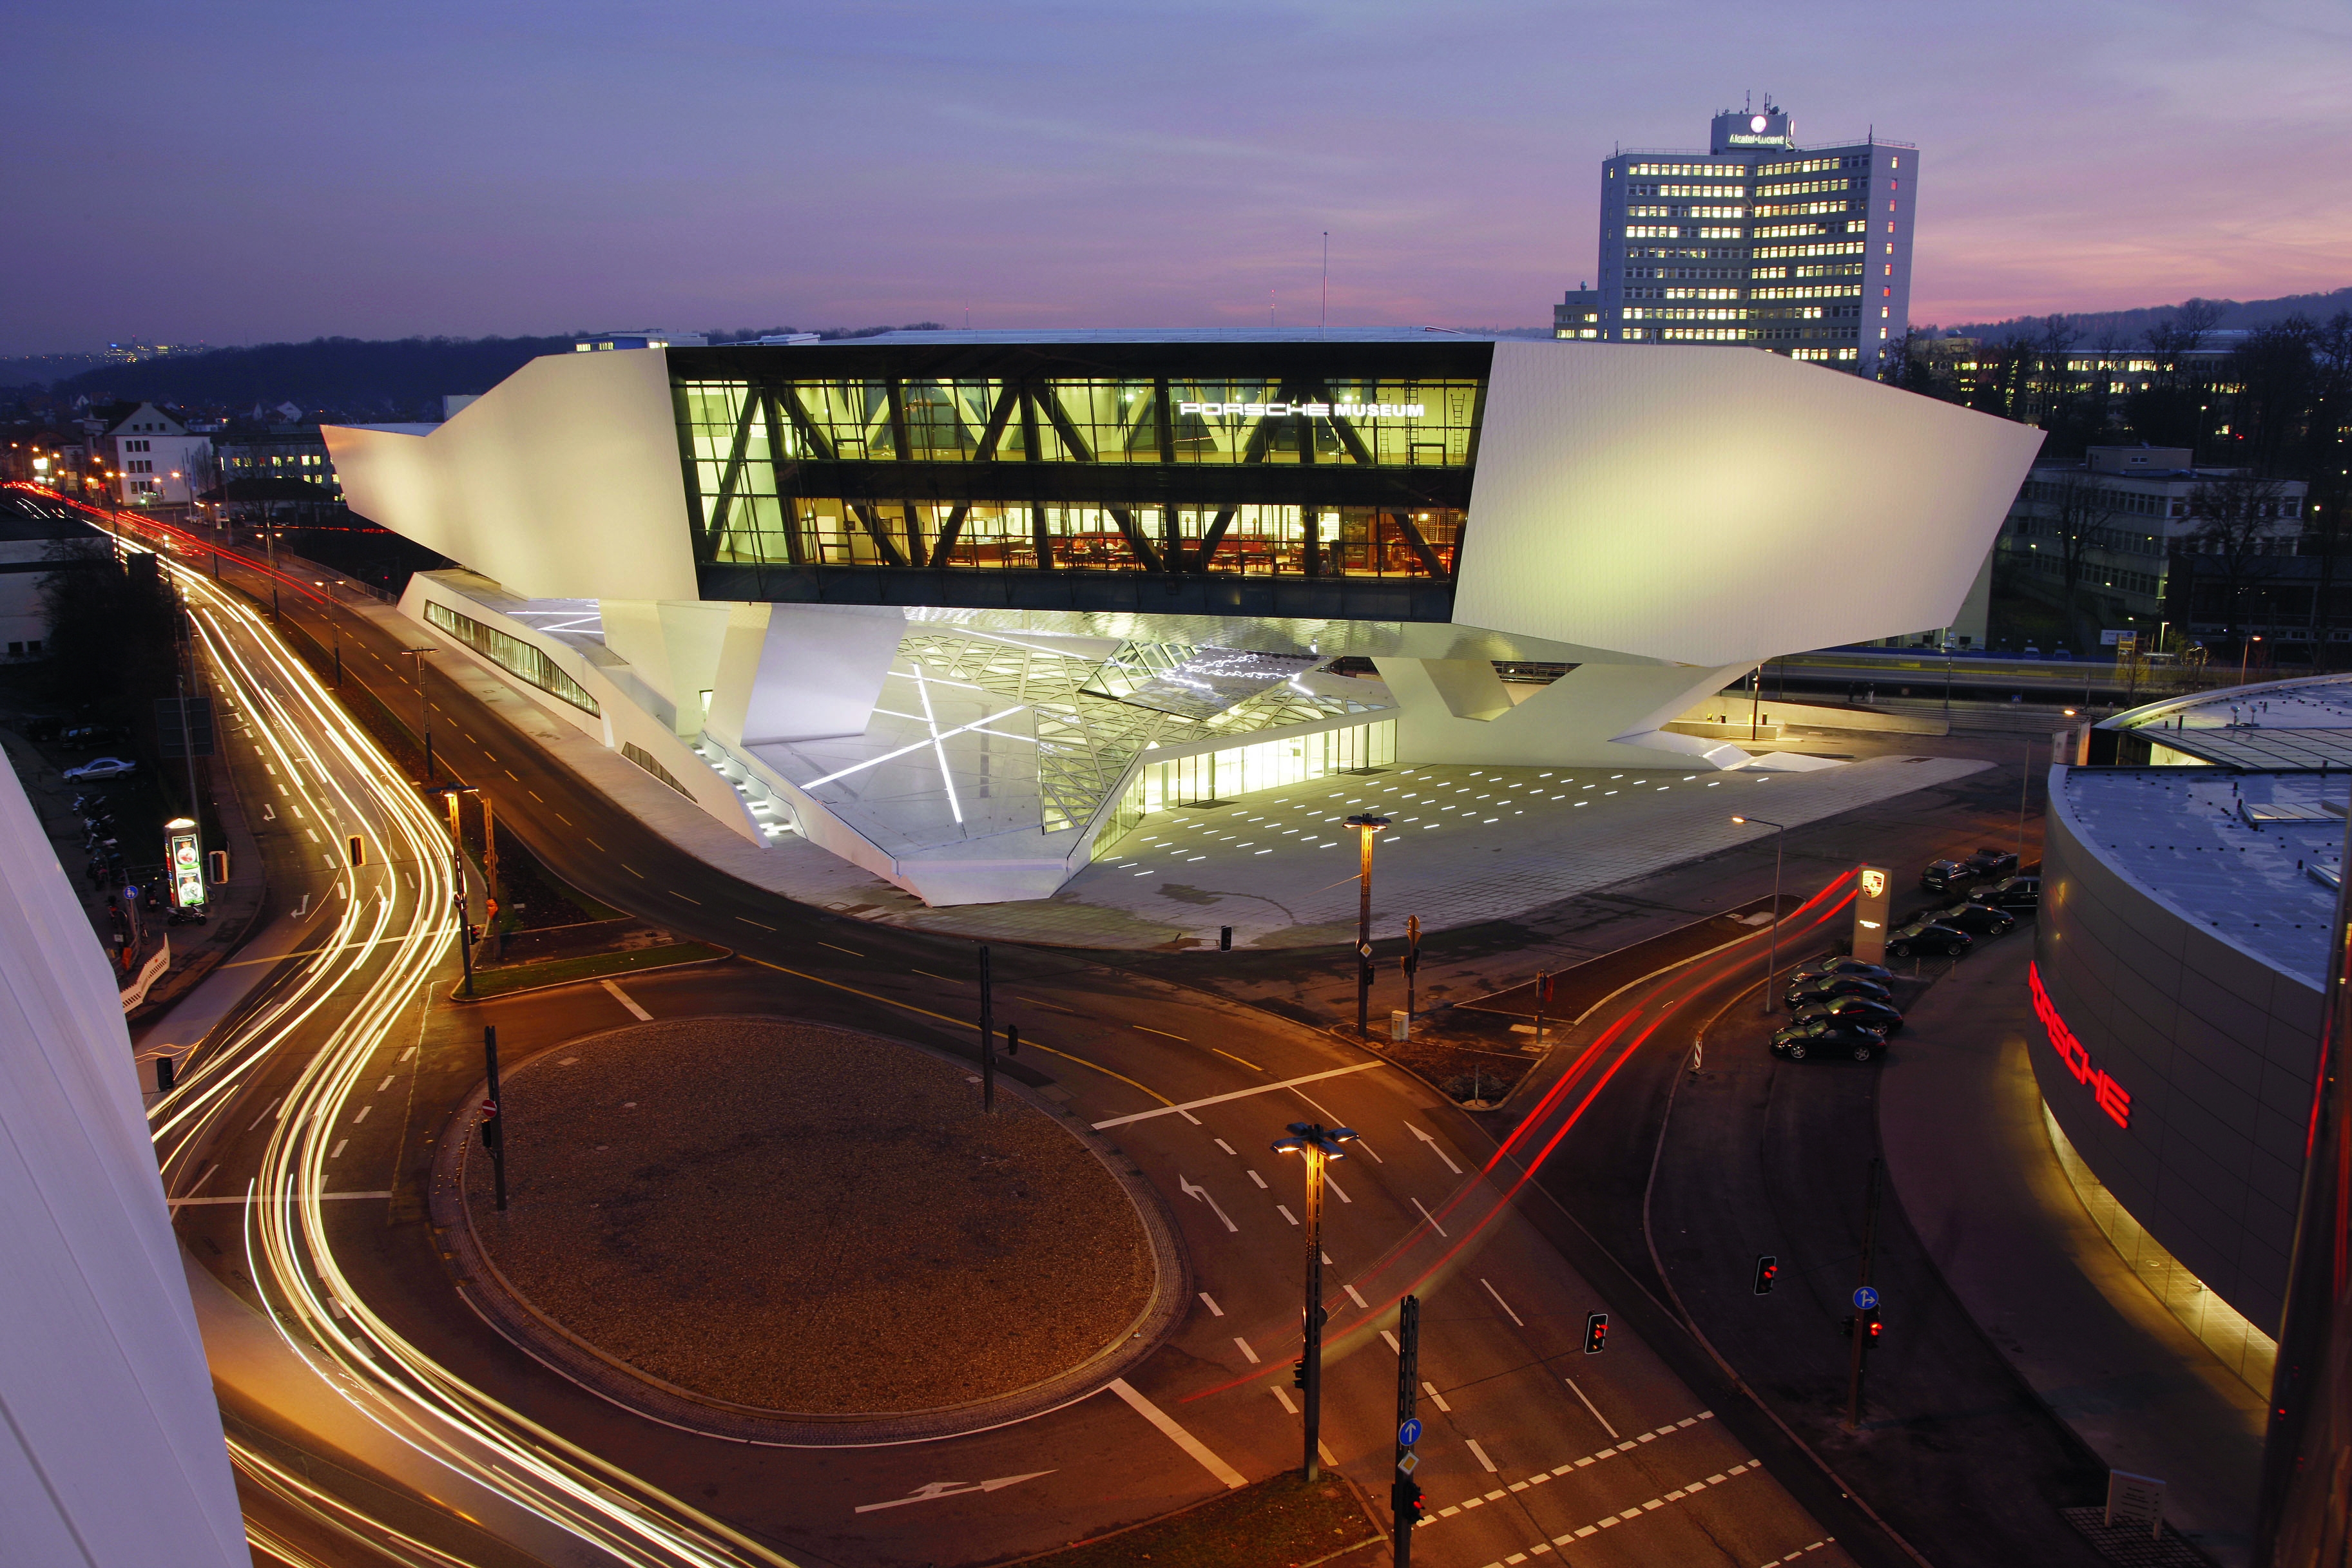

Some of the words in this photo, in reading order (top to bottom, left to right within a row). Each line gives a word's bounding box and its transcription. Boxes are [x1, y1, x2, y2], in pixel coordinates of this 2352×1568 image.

[1180, 403, 1329, 416] PORSCHE
[1334, 403, 1424, 417] MUSEUM
[2029, 960, 2130, 1129] PORSCHE
